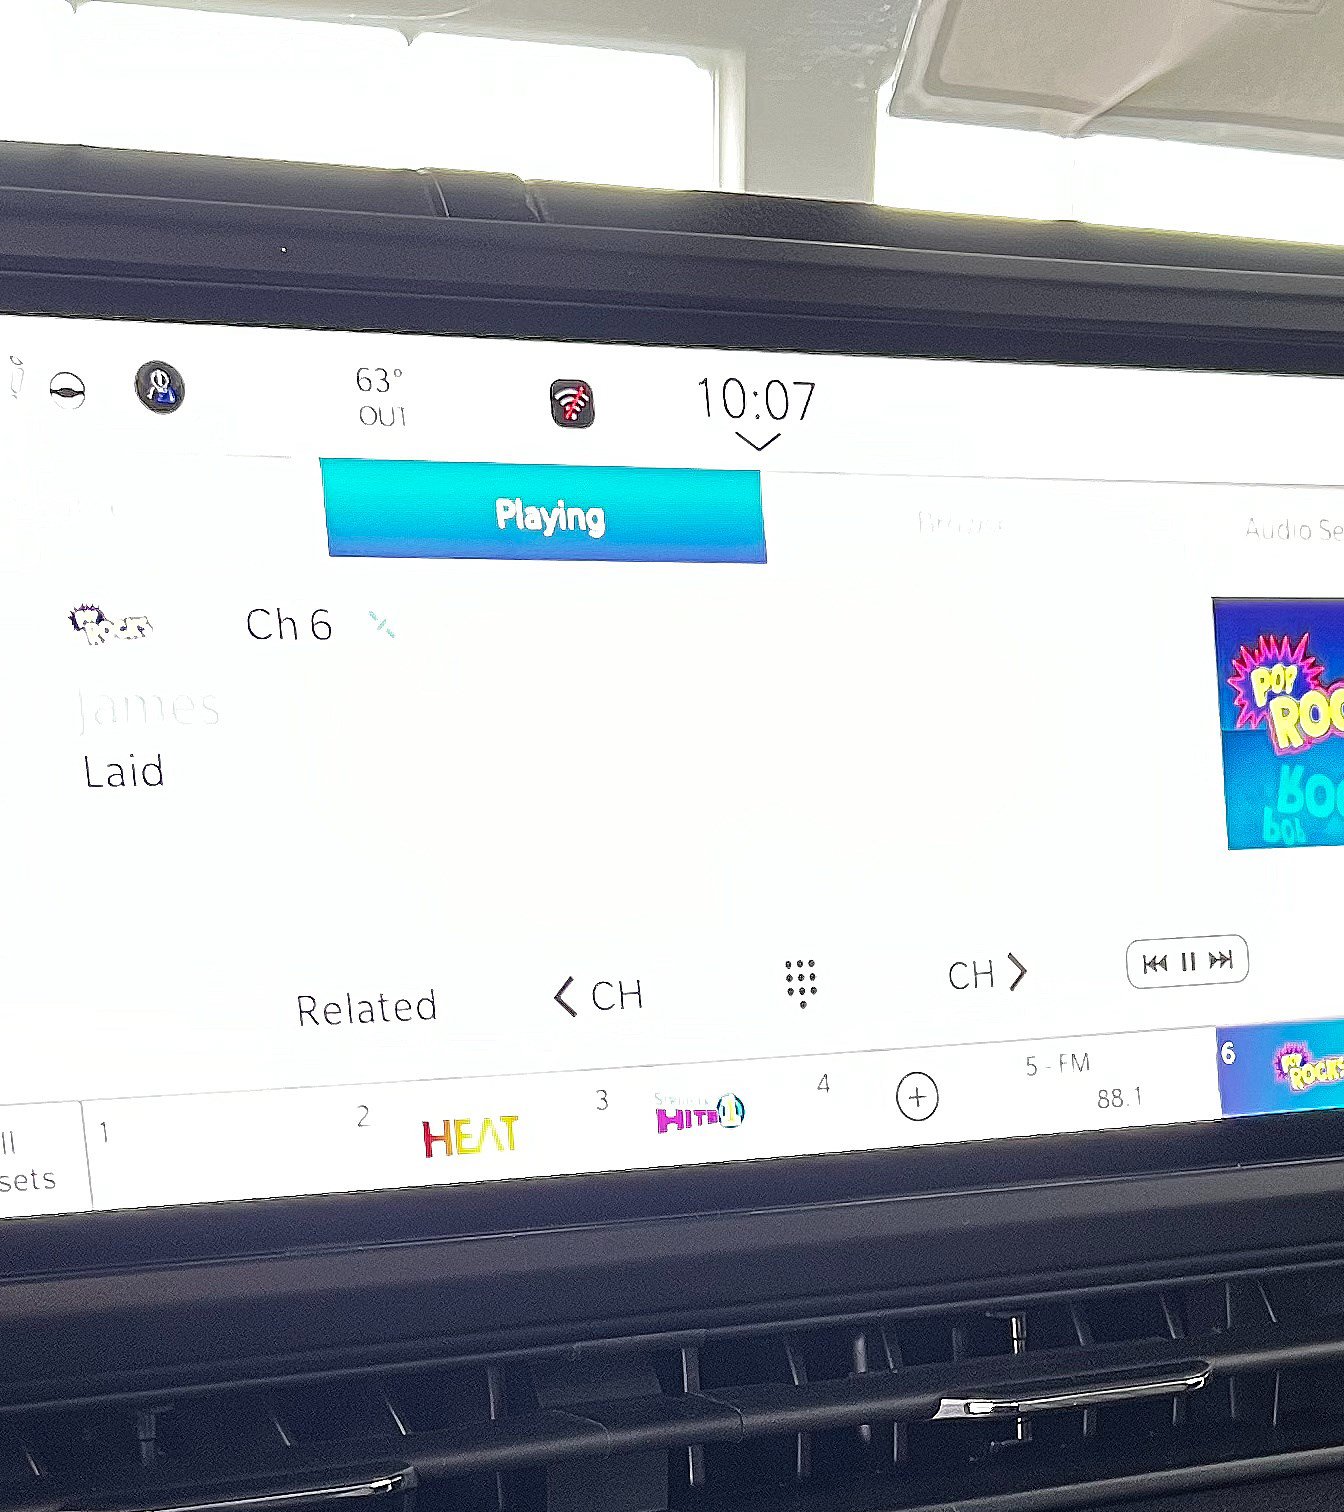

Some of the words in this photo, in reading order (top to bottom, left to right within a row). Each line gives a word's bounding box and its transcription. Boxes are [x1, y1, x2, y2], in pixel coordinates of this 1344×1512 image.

[356, 367, 404, 393] 63°
[698, 377, 816, 421] 10:07
[359, 405, 407, 427] OUT
[496, 497, 605, 538] Playing
[1245, 518, 1312, 542] Audio
[246, 608, 298, 641] Ch
[311, 609, 333, 640] 6
[1250, 663, 1298, 708] POP
[84, 753, 164, 787] Laid
[949, 959, 993, 990] CH
[297, 989, 438, 1027] Related
[591, 979, 643, 1012] CH
[1026, 1056, 1037, 1076] 5
[1059, 1052, 1090, 1073] FM
[1221, 1041, 1236, 1065] 6
[817, 1073, 830, 1094] 4
[596, 1089, 608, 1111] 3
[1097, 1086, 1142, 1109] 88.1
[357, 1105, 370, 1128] 2
[99, 1121, 109, 1144] 1
[421, 1114, 519, 1158] HEAT
